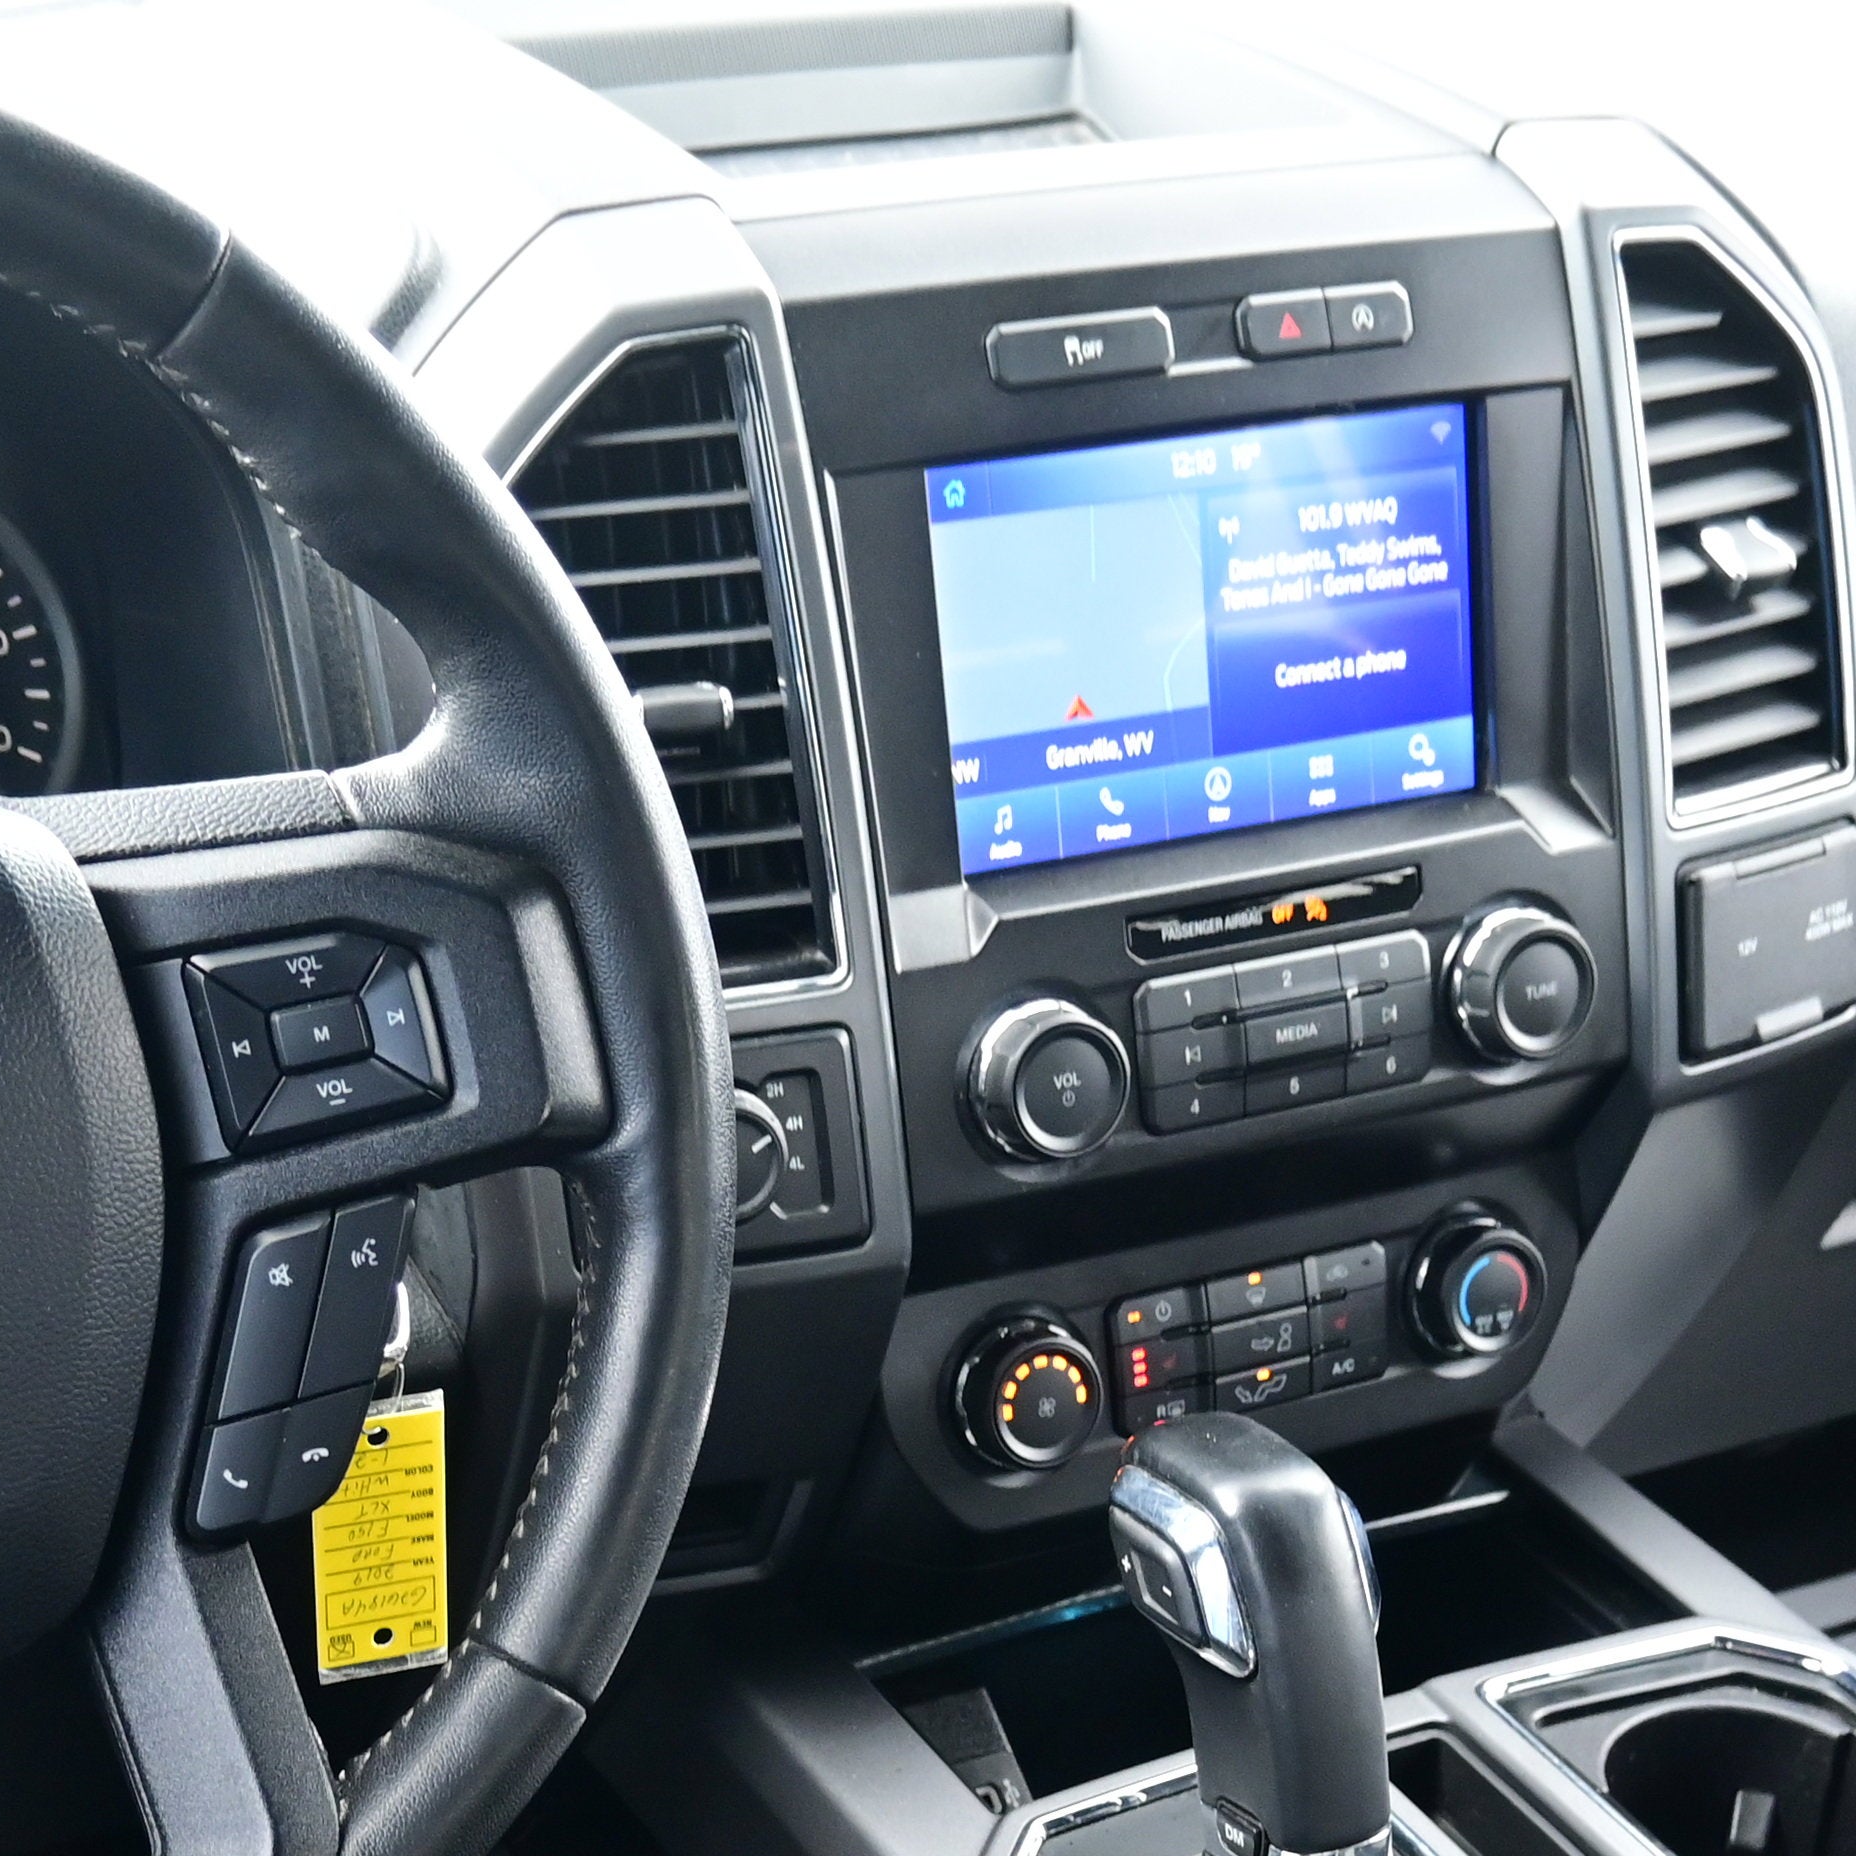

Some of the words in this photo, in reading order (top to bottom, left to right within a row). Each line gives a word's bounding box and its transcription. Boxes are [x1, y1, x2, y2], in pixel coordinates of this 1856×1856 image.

[1345, 496, 1398, 526] WVAQ
[1275, 656, 1342, 688] Connect
[1343, 656, 1355, 679] a
[1356, 649, 1407, 680] phone
[1045, 737, 1123, 771] Granville,
[1124, 729, 1154, 758] WV
[1161, 916, 1224, 944] PASSENGER
[1224, 905, 1263, 932] AIRBAG
[285, 955, 323, 975] VOL
[1380, 951, 1390, 968] 3
[1282, 970, 1293, 988] 2
[1183, 989, 1192, 1006] 1
[1525, 982, 1559, 1002] TUNE
[313, 1025, 330, 1043] M
[1276, 1022, 1318, 1045] MEDIA
[1386, 1056, 1397, 1074] 6
[316, 1078, 353, 1099] VOL
[1053, 1072, 1082, 1091] VOL
[1190, 1098, 1200, 1116] 4
[786, 1114, 803, 1131] 4H
[789, 1155, 805, 1170] 4L
[405, 1464, 434, 1476] COLOR
[410, 1487, 434, 1499] BODY
[406, 1511, 434, 1522] MODEL
[411, 1534, 434, 1544] MAKE
[412, 1557, 435, 1567] YEAR
[353, 1563, 395, 1586] 2019
[413, 1620, 432, 1630] NEW
